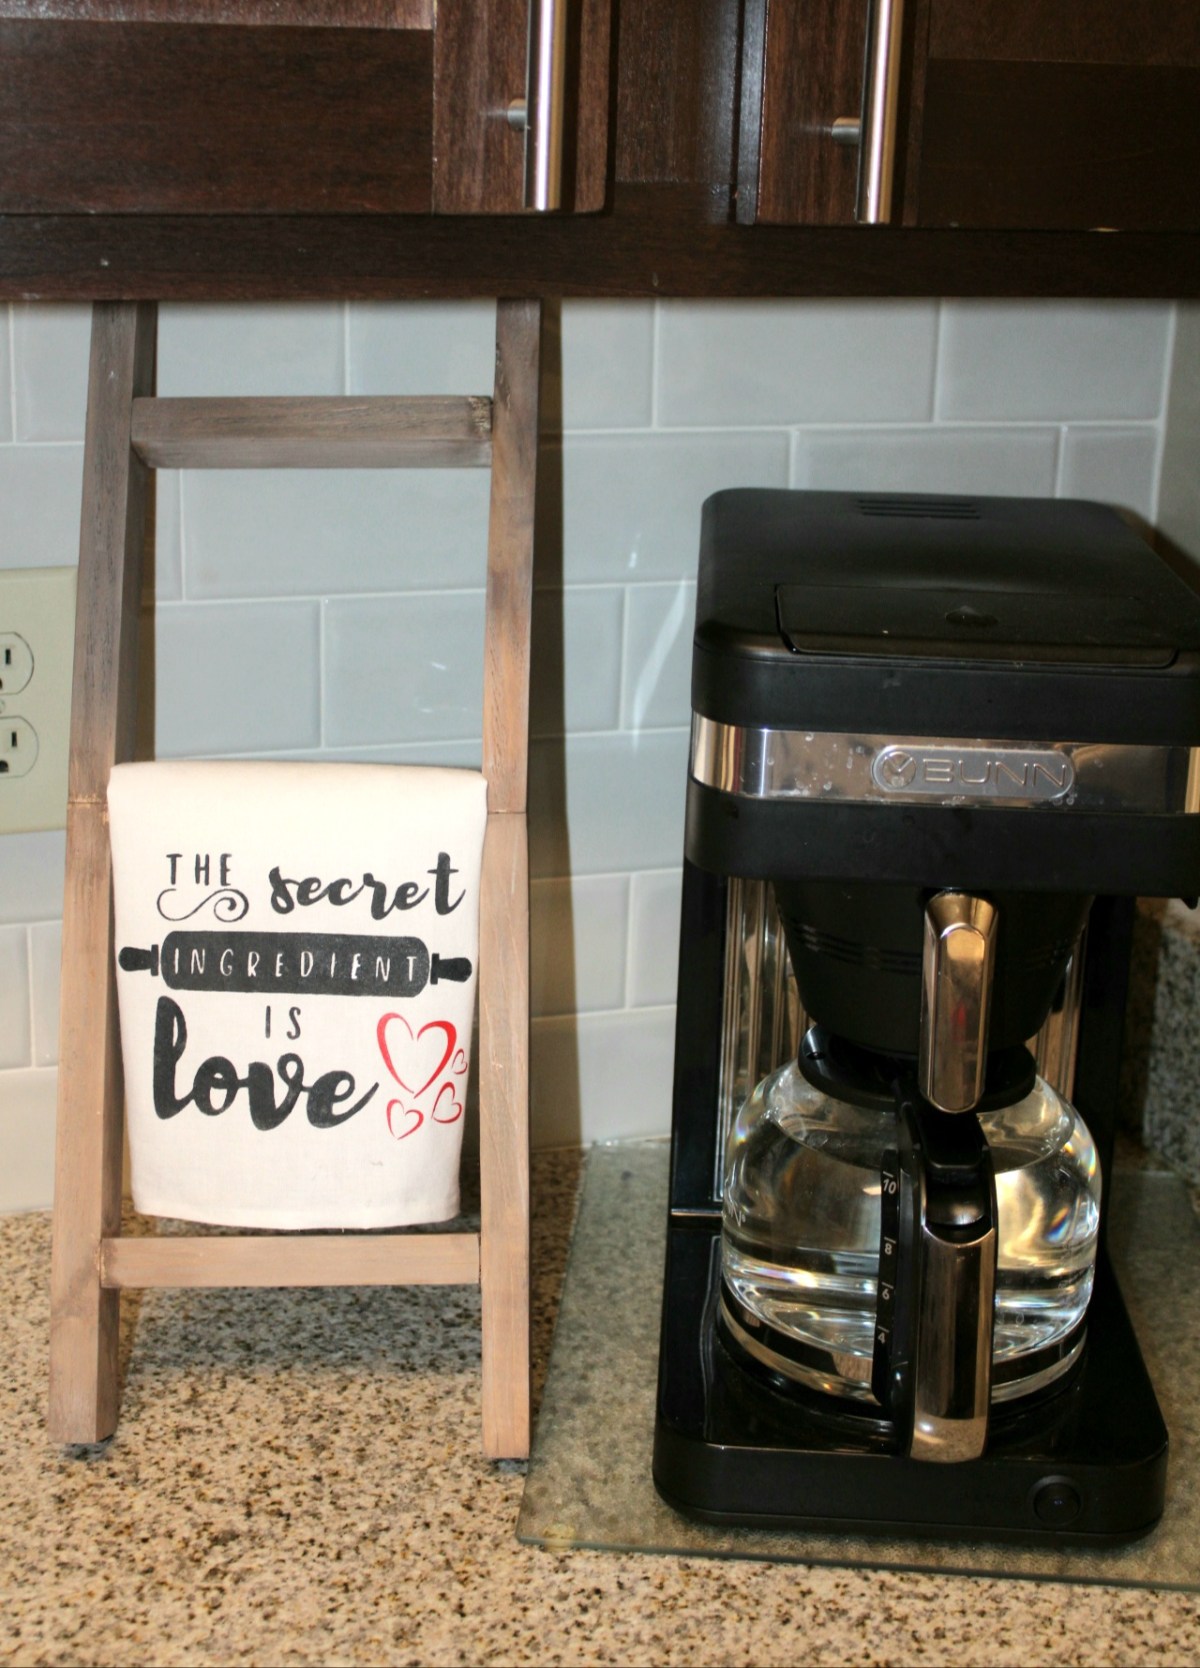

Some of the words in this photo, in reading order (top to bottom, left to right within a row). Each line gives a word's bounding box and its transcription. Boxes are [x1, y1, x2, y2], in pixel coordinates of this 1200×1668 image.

[922, 758, 1066, 788] BUNN
[166, 853, 232, 886] THE
[268, 852, 466, 920] secret
[173, 948, 417, 982] INGREDIENT
[265, 1005, 301, 1040] IS
[153, 996, 379, 1131] love
[882, 1178, 897, 1194] 10
[884, 1242, 893, 1255] 8
[882, 1288, 890, 1301] 6
[877, 1332, 886, 1344] 4
